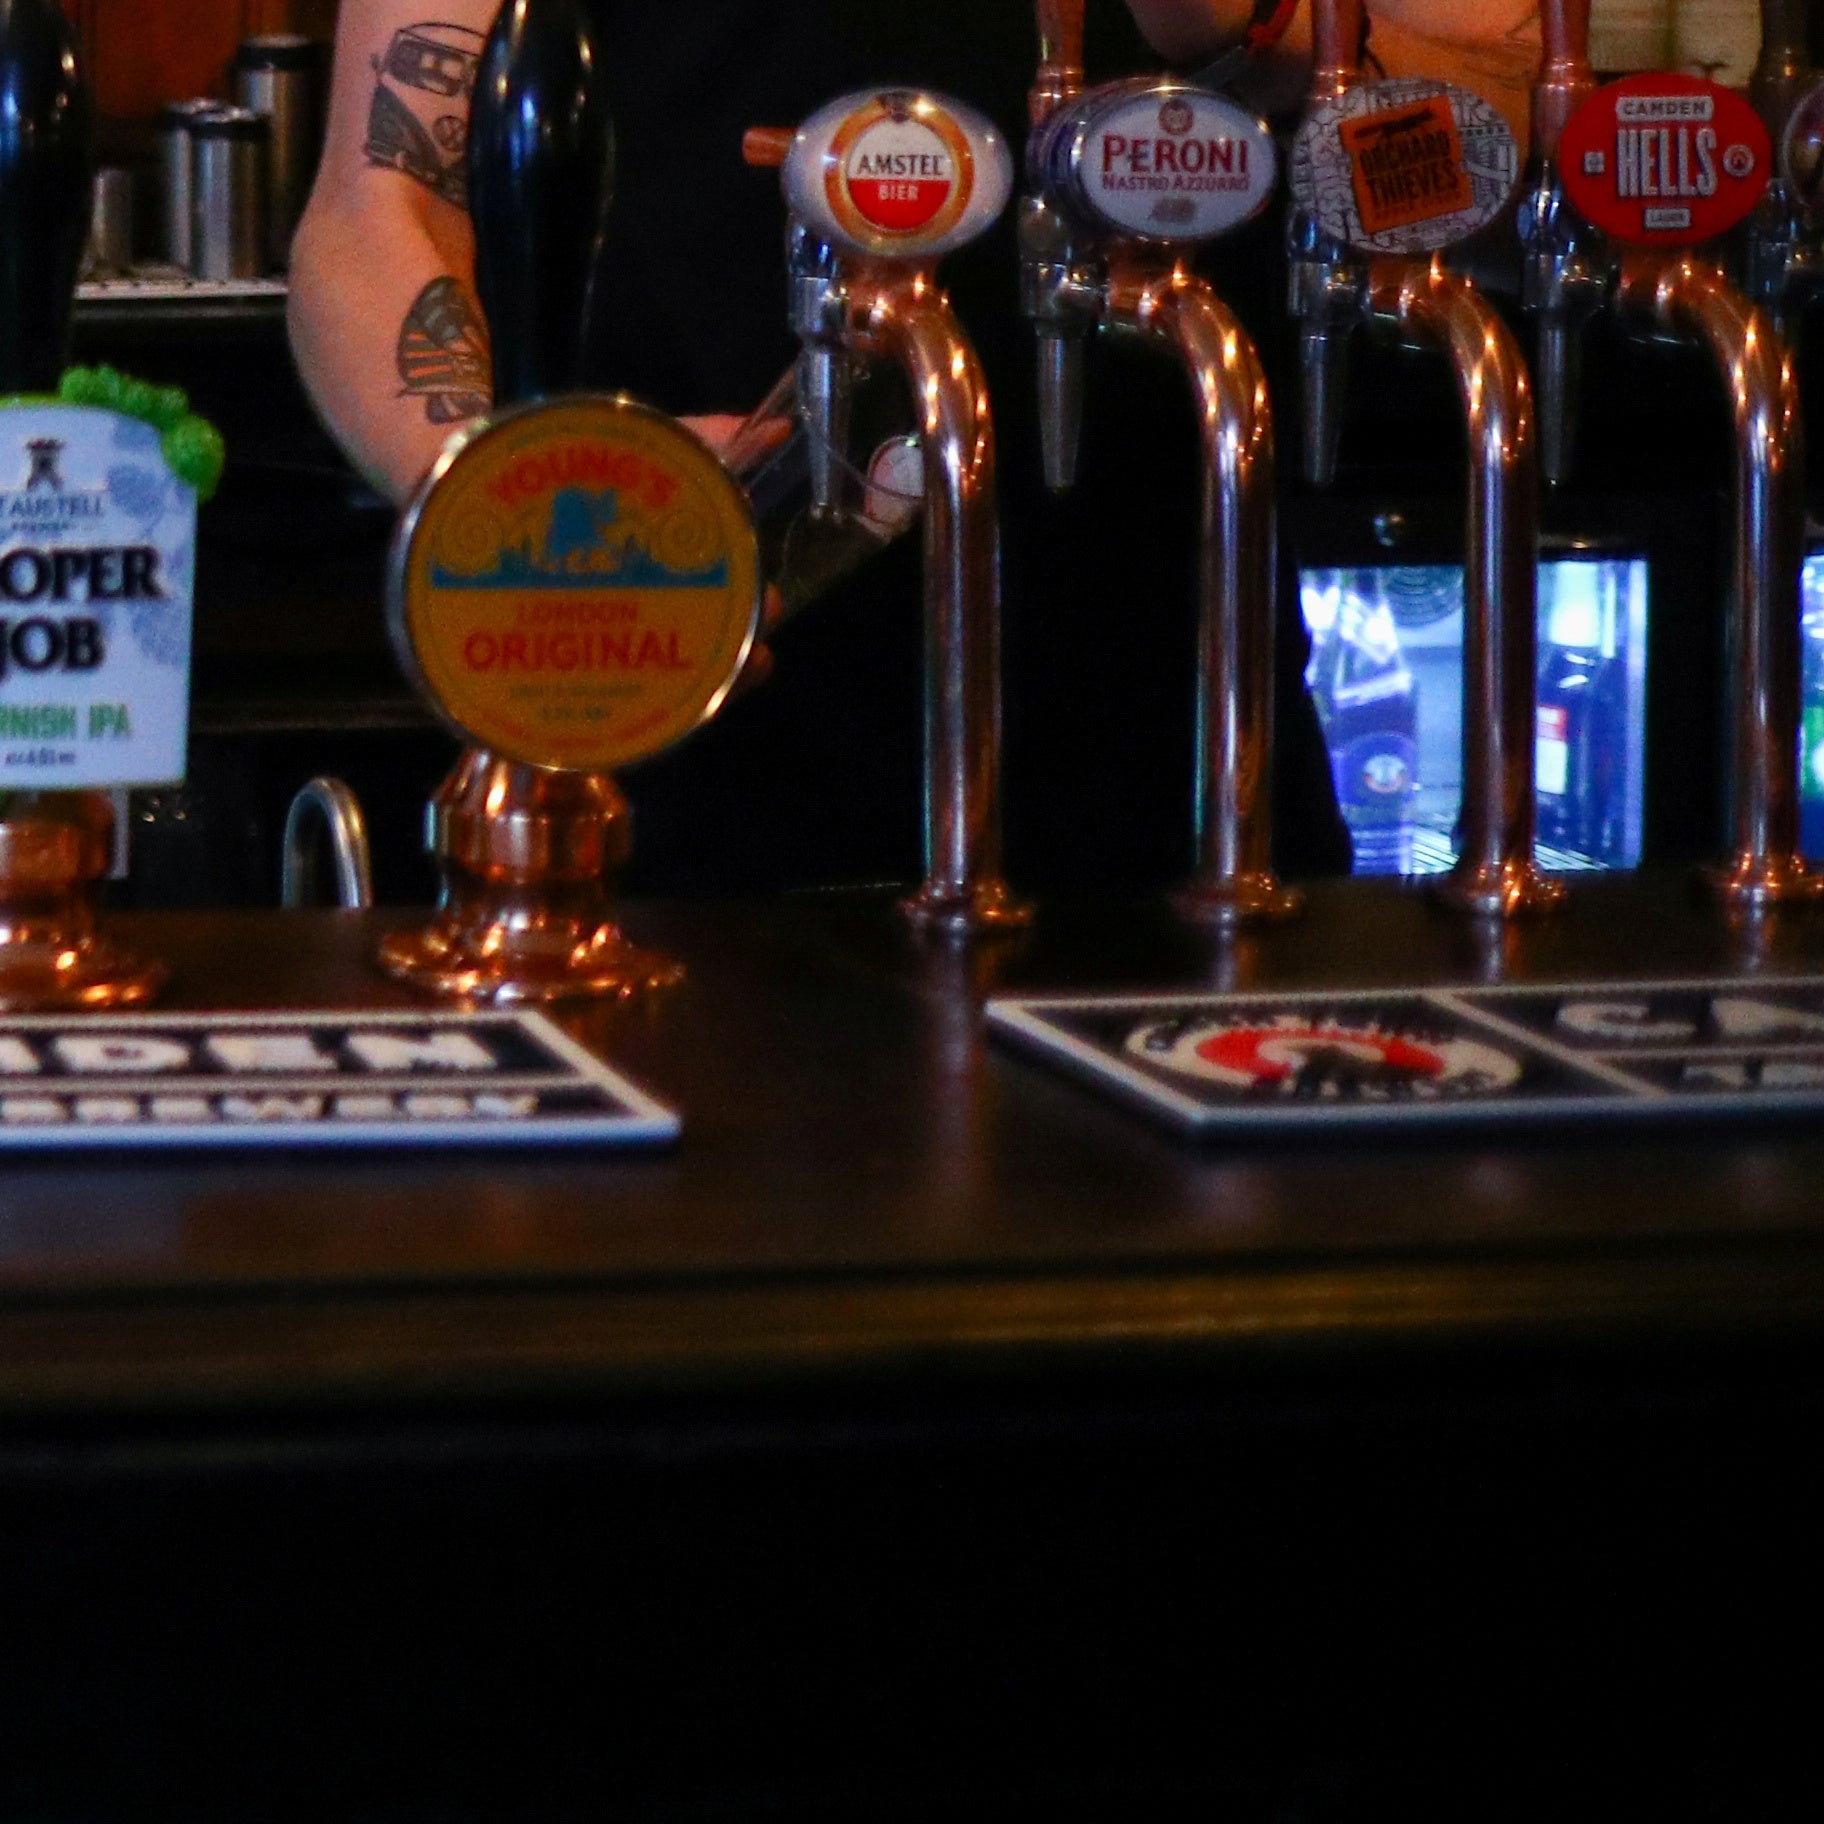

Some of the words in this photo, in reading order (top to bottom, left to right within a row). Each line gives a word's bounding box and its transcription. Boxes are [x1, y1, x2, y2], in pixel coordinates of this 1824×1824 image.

[1622, 101, 1707, 116] CAMDEN
[858, 154, 947, 176] AMSTEL
[1102, 133, 1250, 174] PERONI
[1616, 128, 1718, 198] HELLS
[877, 184, 920, 201] BIER
[1366, 157, 1460, 208] THIEVES
[488, 439, 680, 508] YOUNG'S
[516, 601, 639, 624] LONDON
[463, 635, 692, 673] ORIGINAL
[88, 703, 132, 740] IPA
